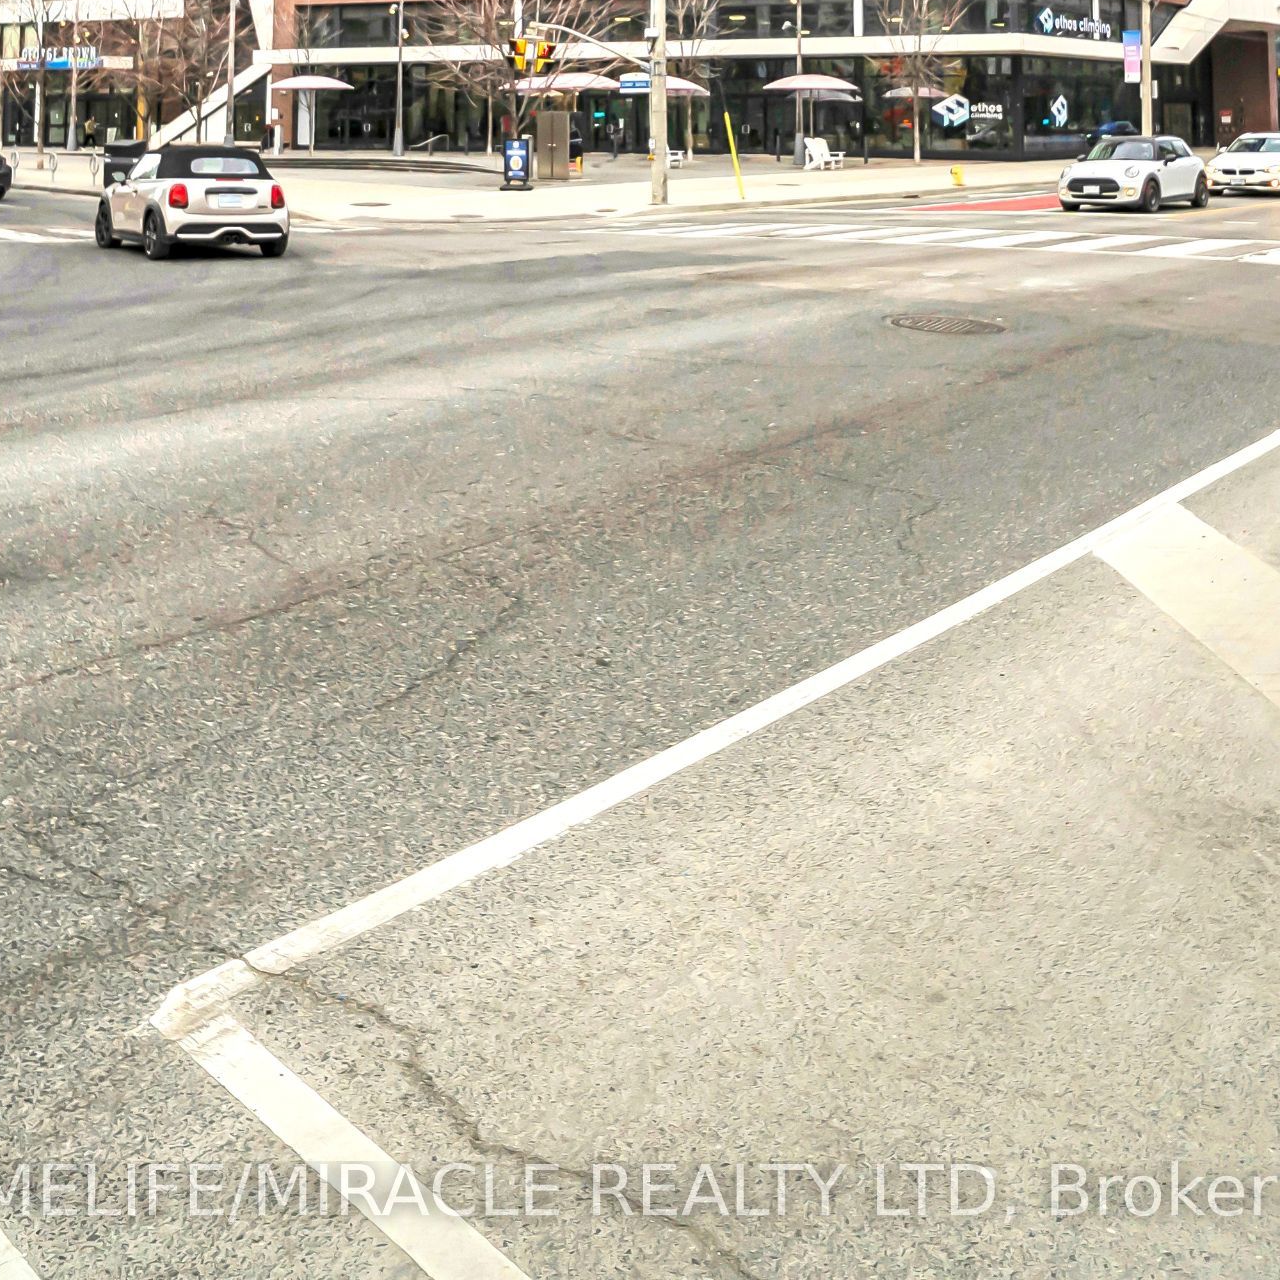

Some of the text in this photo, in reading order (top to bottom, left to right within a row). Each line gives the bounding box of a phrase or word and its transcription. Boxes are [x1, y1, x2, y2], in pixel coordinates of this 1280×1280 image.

[1055, 15, 1111, 39] ethos climbing
[971, 102, 1003, 113] ethos
[971, 112, 1003, 120] climbing
